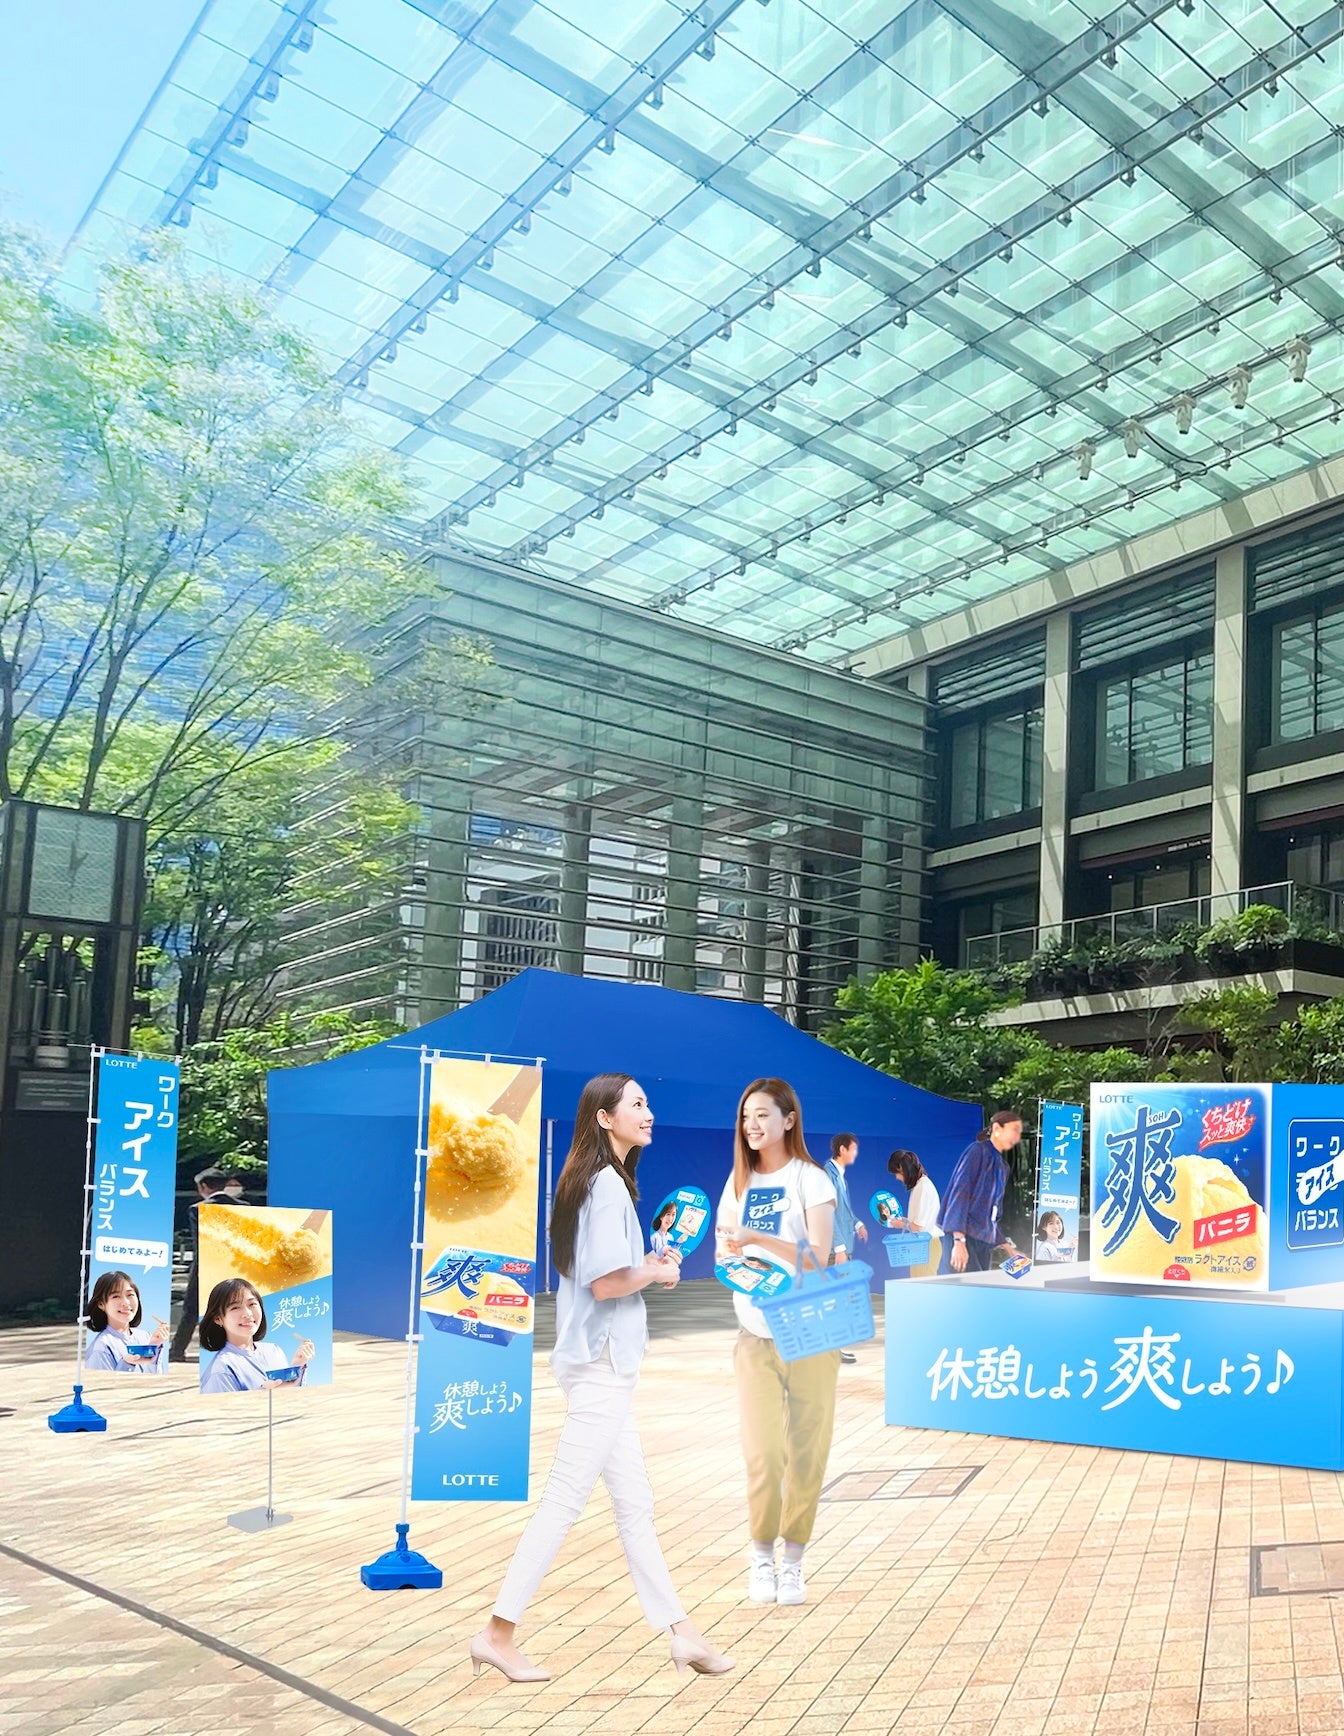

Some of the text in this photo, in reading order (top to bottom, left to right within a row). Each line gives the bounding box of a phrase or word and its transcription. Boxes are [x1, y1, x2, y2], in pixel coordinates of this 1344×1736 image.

[105, 1059, 138, 1069] LOTTE
[157, 1075, 175, 1128] ワーク
[1099, 1095, 1134, 1104] LOTTE
[1071, 1113, 1081, 1140] ワーク
[119, 1101, 154, 1198] アイス
[1053, 1126, 1070, 1176] アイス
[1296, 1136, 1340, 1157] ワーク
[1042, 1157, 1052, 1191] バランス
[1102, 1105, 1182, 1256] 爽
[1305, 1163, 1335, 1200] アイス
[97, 1163, 117, 1231] バランス
[750, 1193, 779, 1202] ワーク
[746, 1220, 775, 1231] バランス
[1198, 1211, 1250, 1242] バニラ
[1295, 1208, 1339, 1231] バランス
[1195, 1254, 1241, 1266] ラクトアイス
[421, 1255, 491, 1300] 爽
[279, 1295, 320, 1310] 休憩しよう
[489, 1296, 525, 1305] バニラ
[443, 1380, 508, 1400] 休憩しよう
[442, 1474, 499, 1486] LOTTE
